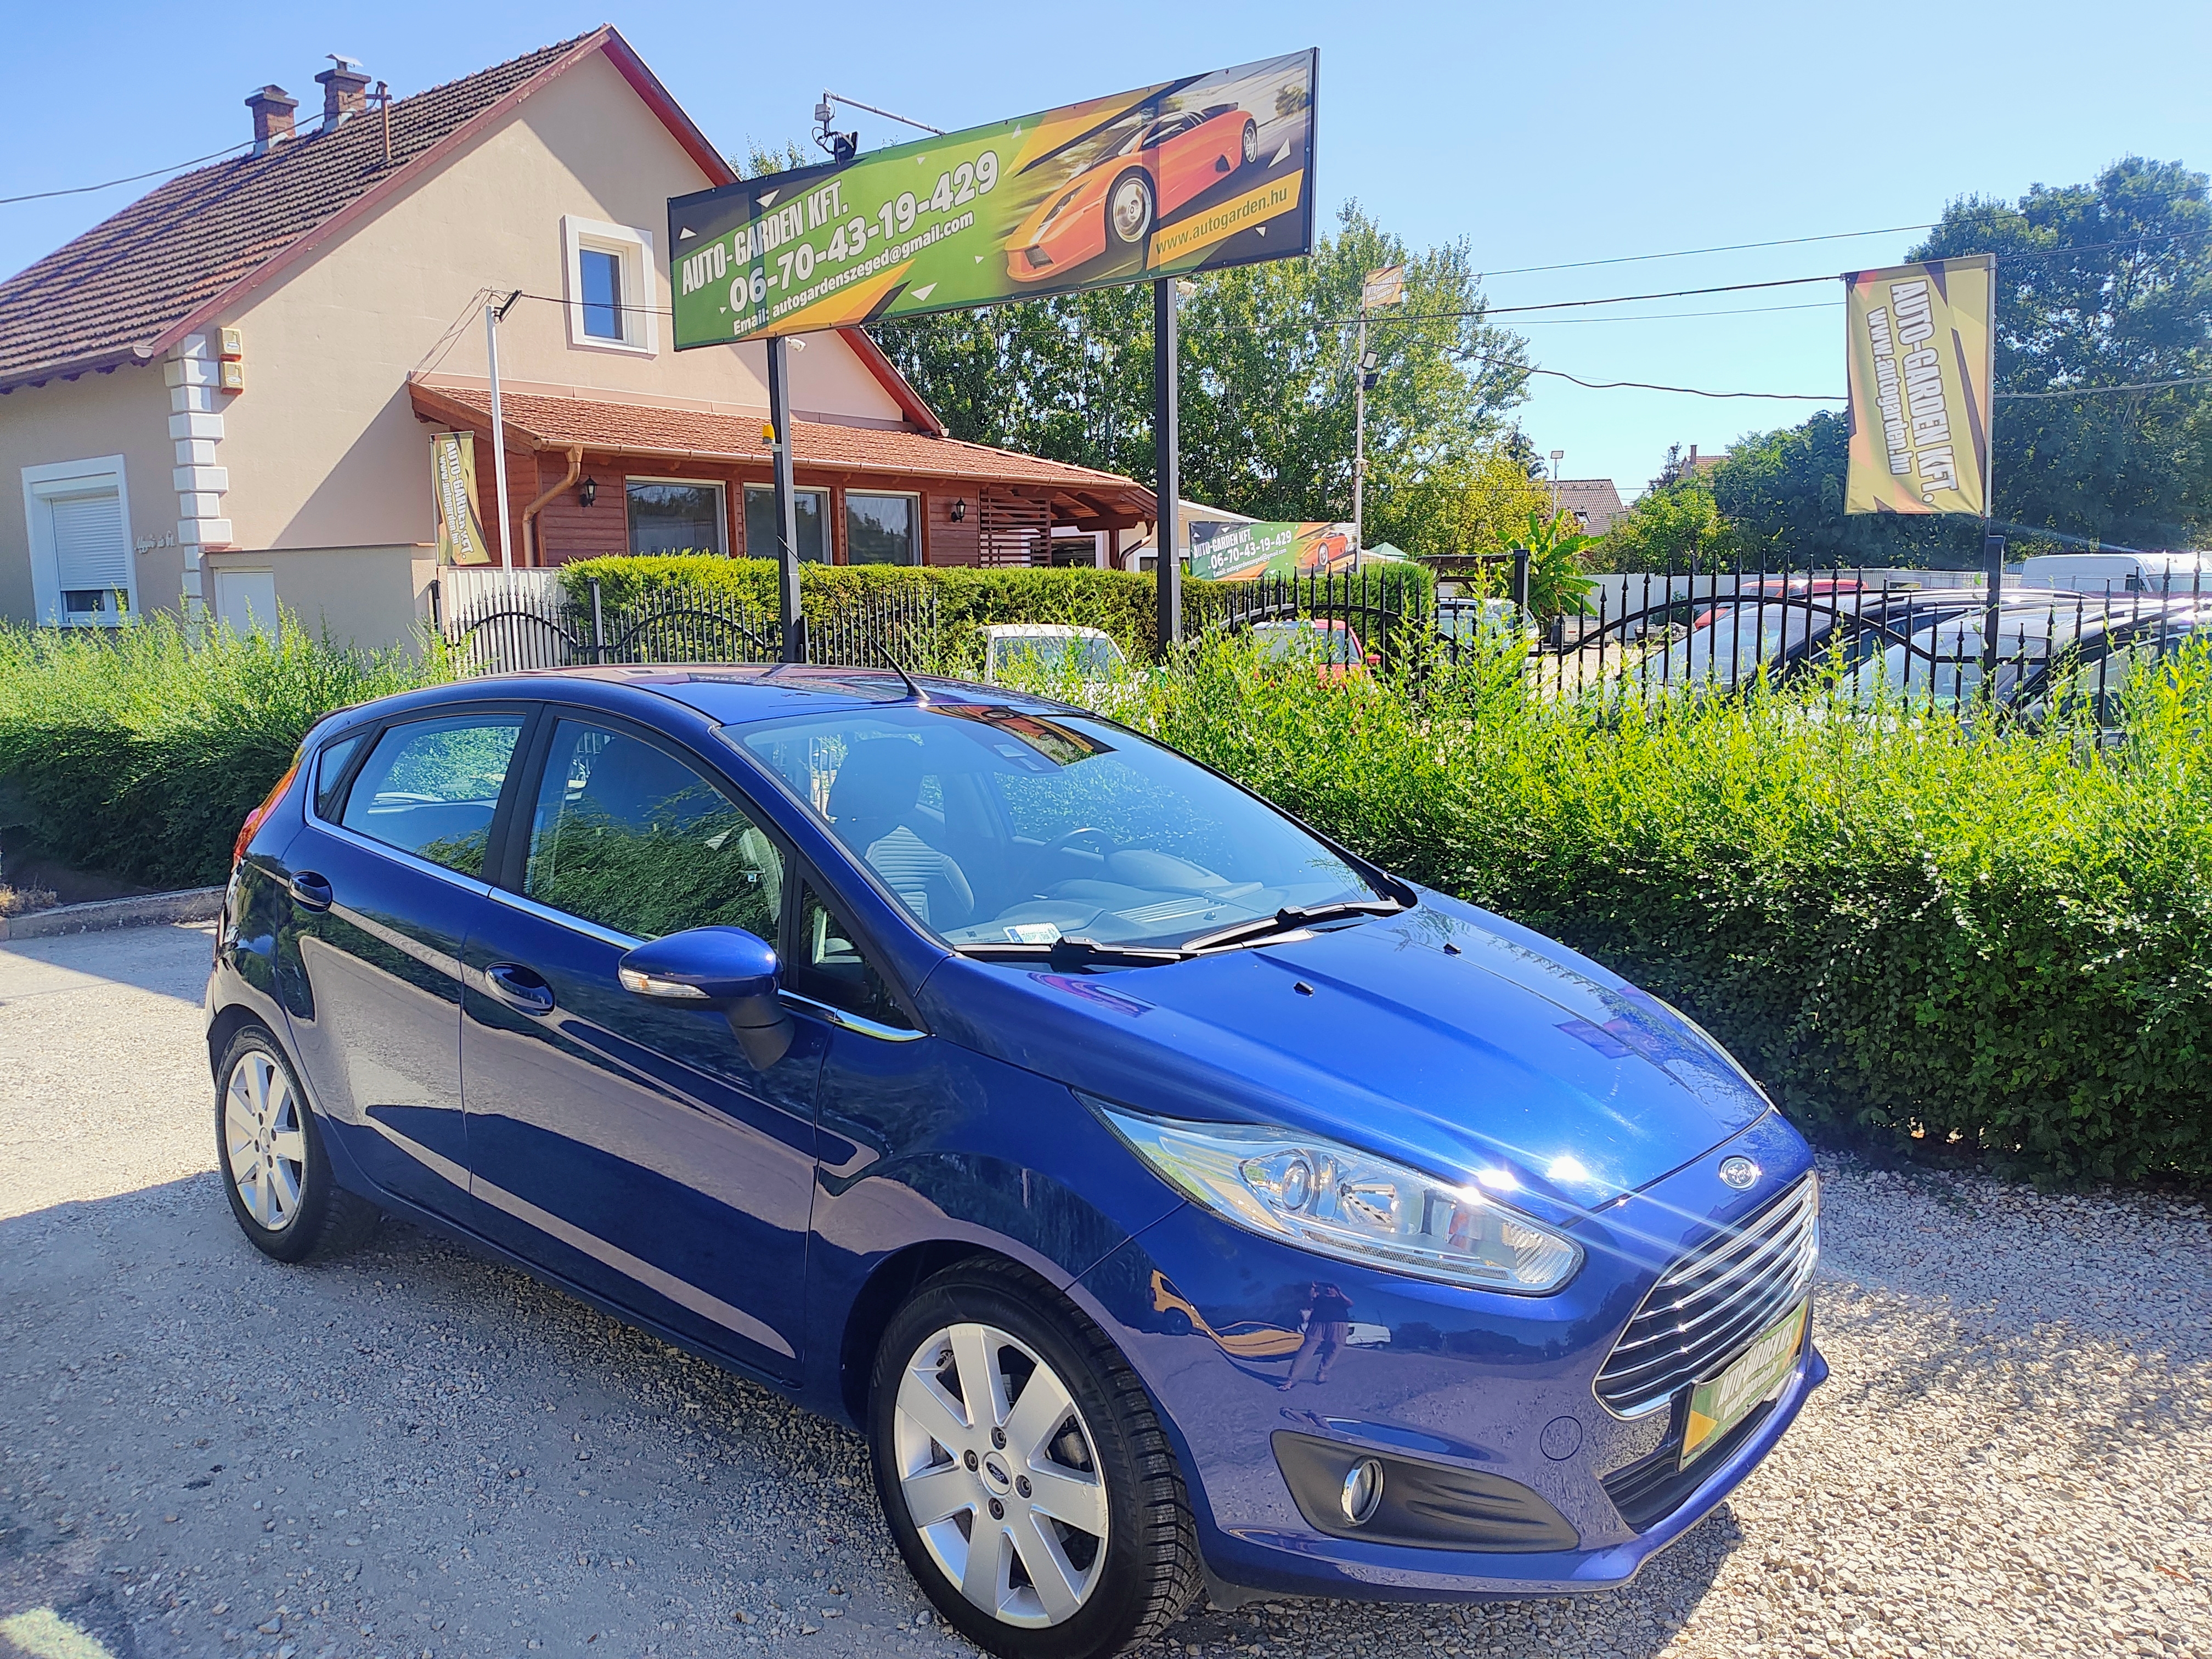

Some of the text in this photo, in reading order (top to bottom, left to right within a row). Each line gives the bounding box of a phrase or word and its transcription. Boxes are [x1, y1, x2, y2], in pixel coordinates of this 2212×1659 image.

[681, 179, 849, 296] AUTO-GARDEN KFT.
[729, 150, 999, 313] 06-70-43-19-429
[1155, 187, 1288, 255] www.autogarden.hu
[732, 210, 974, 336] Email: autogardenszeged@gmail.com
[1866, 306, 1914, 475] www.autogarden.hu
[1890, 279, 1959, 504] AUTO-GARDEN KFT.
[439, 454, 460, 545] www.autogarden.hu
[445, 441, 467, 531] AUTO-GARDEN
[1194, 528, 1254, 558] AUTO-GARDEN KFT.
[1211, 530, 1292, 569] 06-70-43-19-429
[1213, 548, 1286, 577] Email: autogardenszeged@gmail.com
[989, 1465, 1005, 1481] Ford
